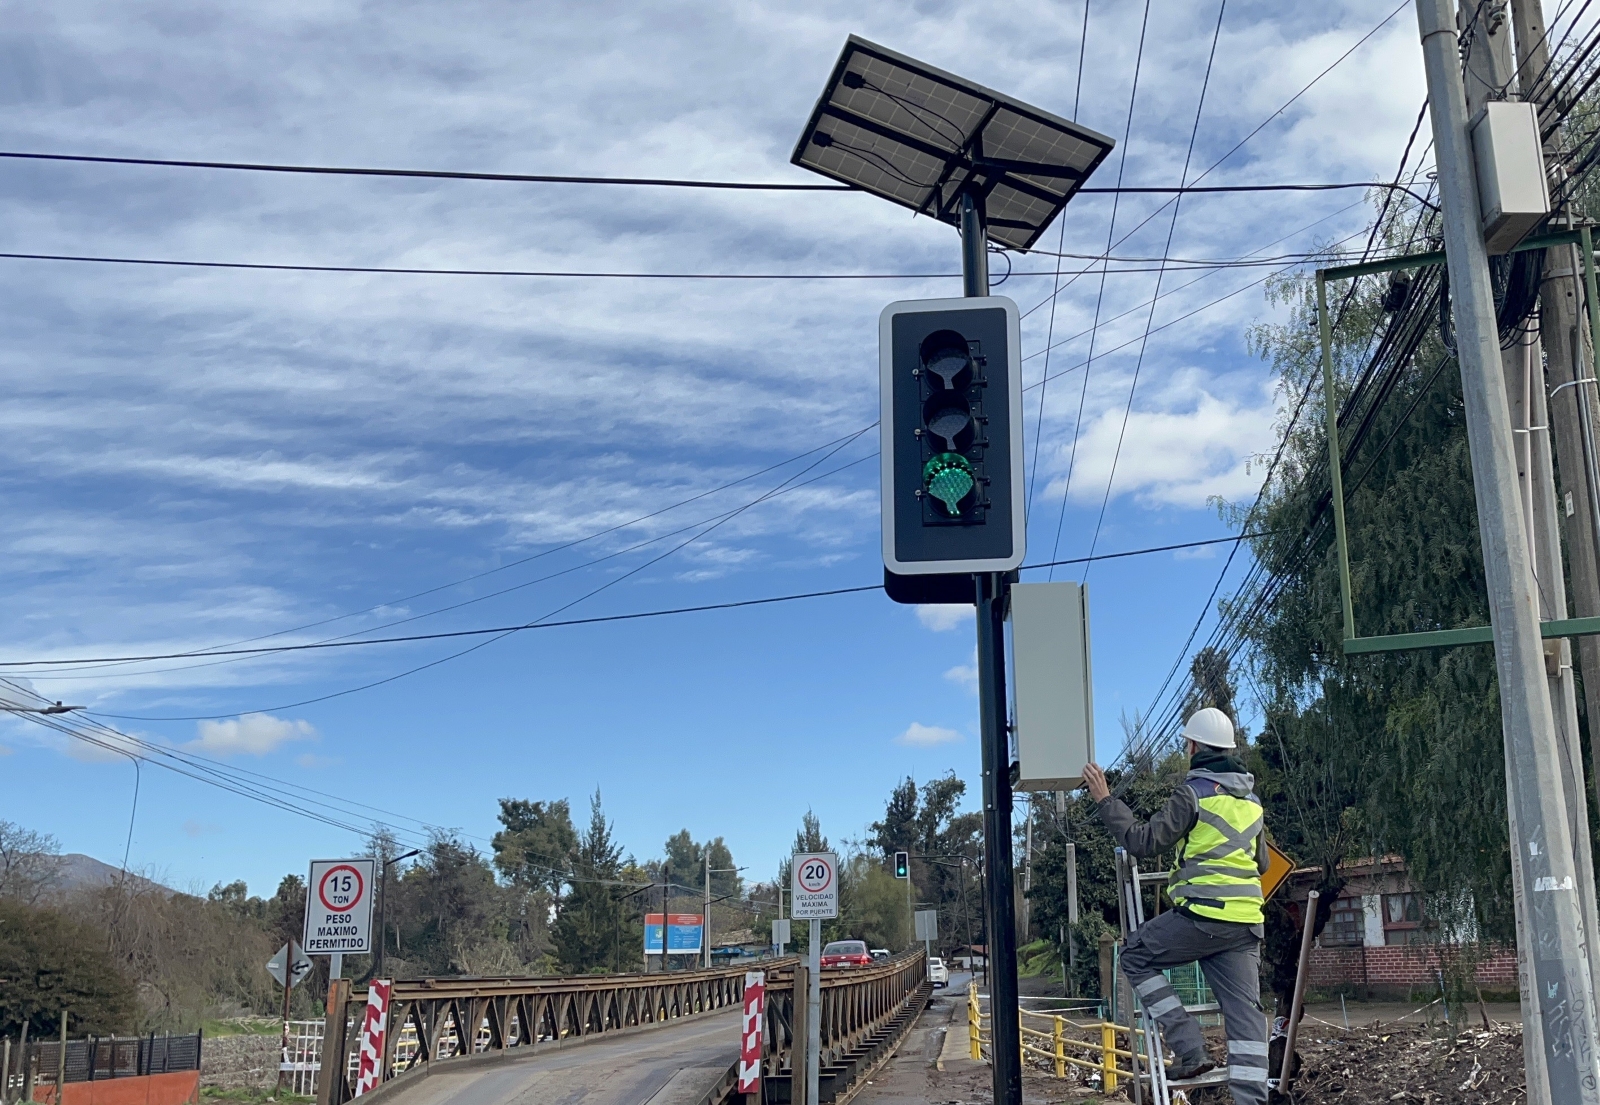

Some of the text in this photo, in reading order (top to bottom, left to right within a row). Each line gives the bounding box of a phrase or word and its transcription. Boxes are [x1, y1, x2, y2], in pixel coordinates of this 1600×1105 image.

[805, 865, 825, 879] 20
[331, 876, 351, 892] 15
[333, 895, 349, 904] TON
[796, 893, 834, 901] VELOCIDAD
[326, 914, 352, 924] PESO
[317, 926, 358, 936] MAXIMO
[309, 938, 364, 949] PERMITIDO
